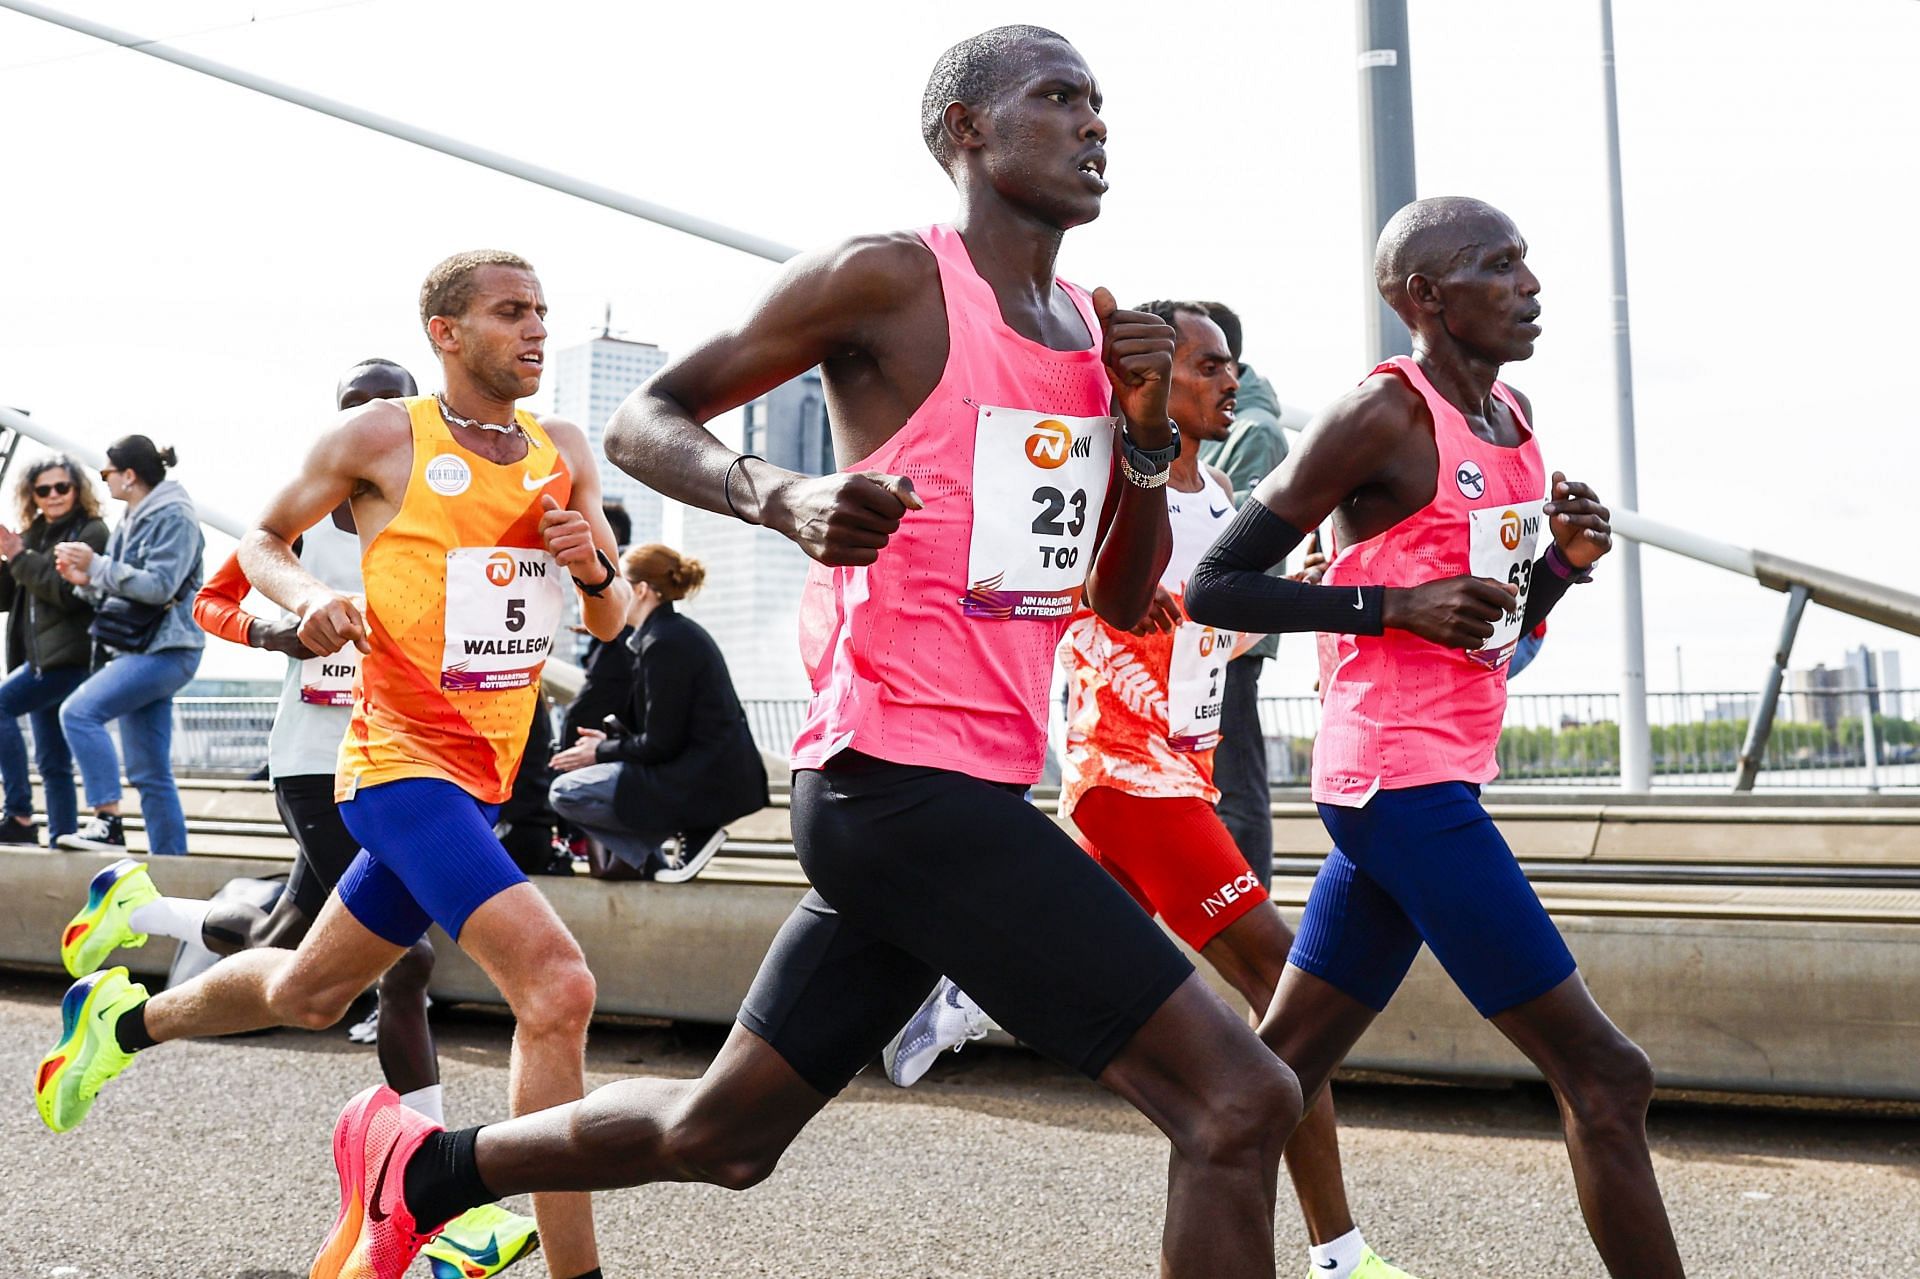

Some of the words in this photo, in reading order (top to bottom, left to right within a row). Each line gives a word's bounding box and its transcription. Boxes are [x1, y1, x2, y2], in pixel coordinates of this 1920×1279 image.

[1070, 435, 1091, 458] NN
[1032, 486, 1087, 537] 23
[1523, 516, 1540, 536] NN
[519, 561, 547, 577] NN
[1039, 546, 1078, 569] TOO
[1508, 559, 1532, 597] 63
[1022, 595, 1037, 605] NN
[505, 599, 526, 633] 5
[463, 636, 550, 655] WALELEGN
[1201, 870, 1259, 917] INEOS
